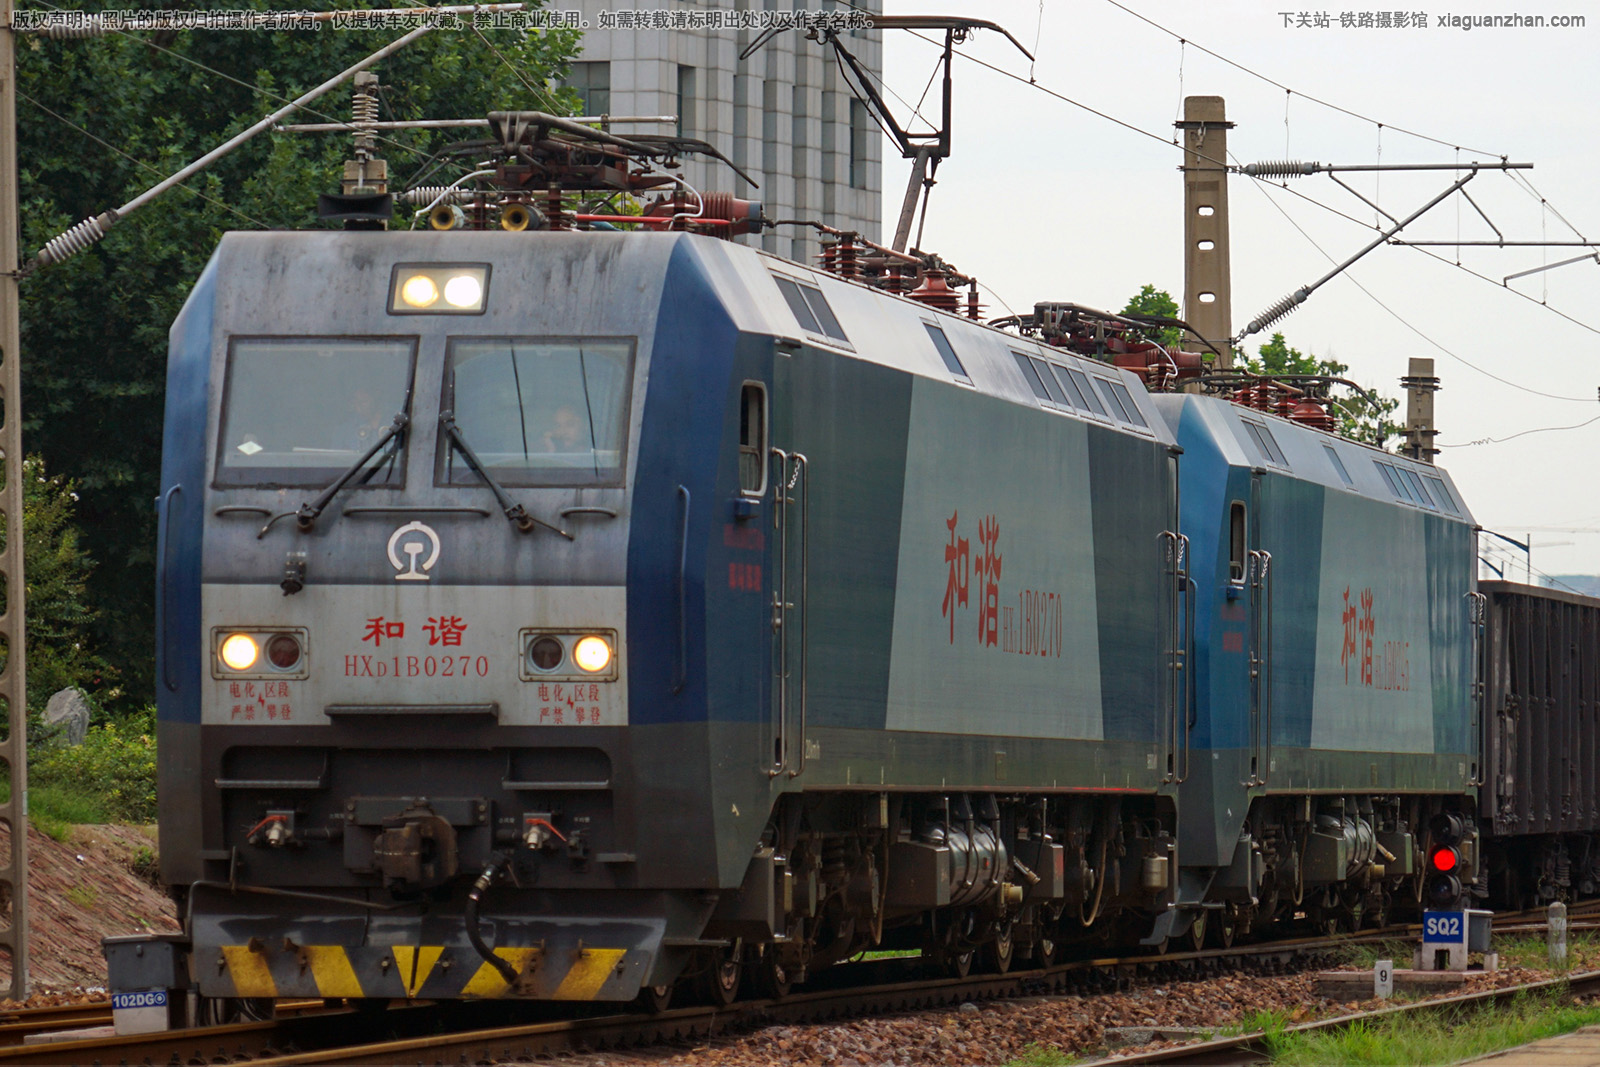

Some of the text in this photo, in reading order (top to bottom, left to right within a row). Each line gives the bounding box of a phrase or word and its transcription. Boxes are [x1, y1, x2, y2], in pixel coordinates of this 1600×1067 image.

[942, 508, 1003, 649] 和谐
[361, 615, 468, 647] 和谐
[1341, 584, 1375, 688] 和谐
[344, 654, 489, 677] HXD1B0270
[1427, 917, 1459, 936] SQ2
[1380, 969, 1388, 982] 9
